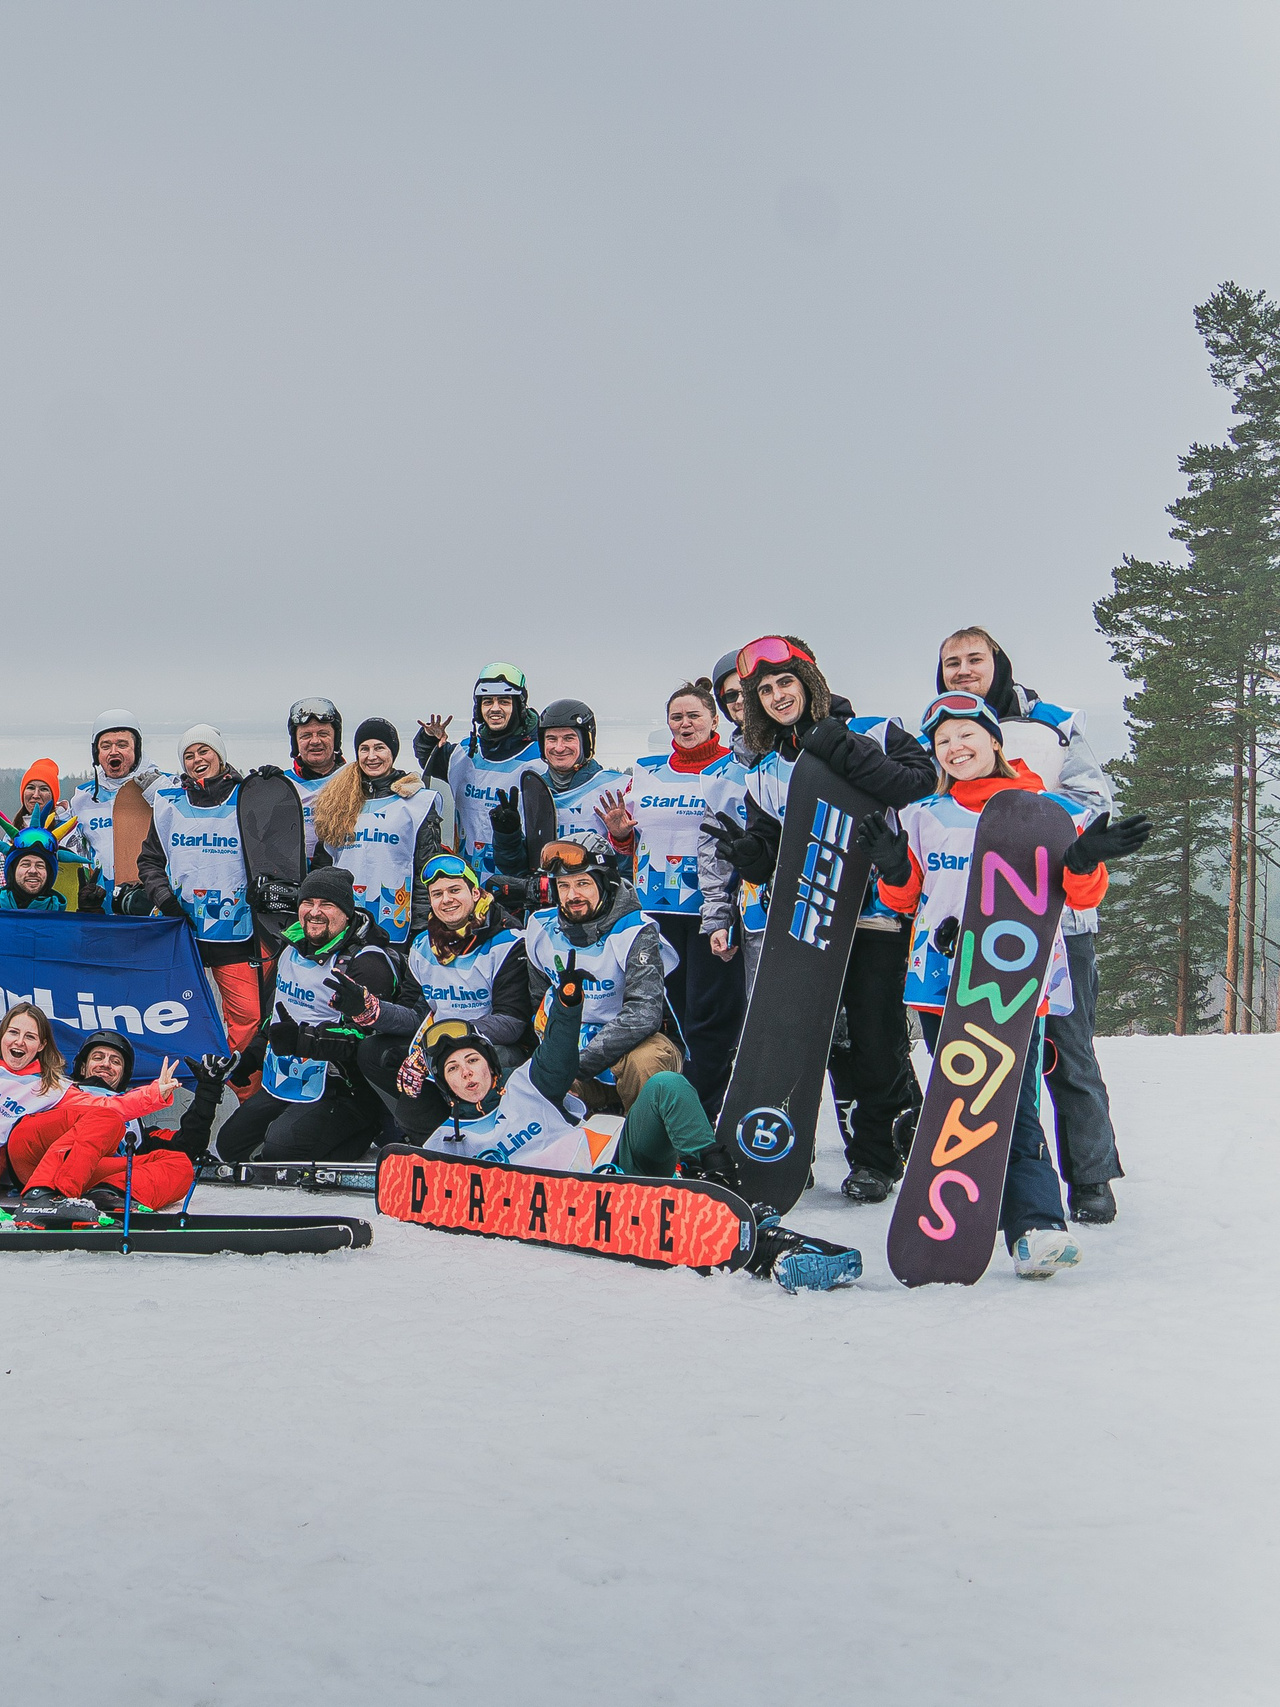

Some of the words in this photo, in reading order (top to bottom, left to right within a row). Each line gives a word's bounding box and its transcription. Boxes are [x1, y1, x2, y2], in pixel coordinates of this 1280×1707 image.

[640, 794, 705, 808] StarLin
[171, 833, 238, 848] StarLine
[927, 852, 973, 871] Star
[788, 798, 853, 950] RIDE
[422, 984, 489, 1000] StarLine
